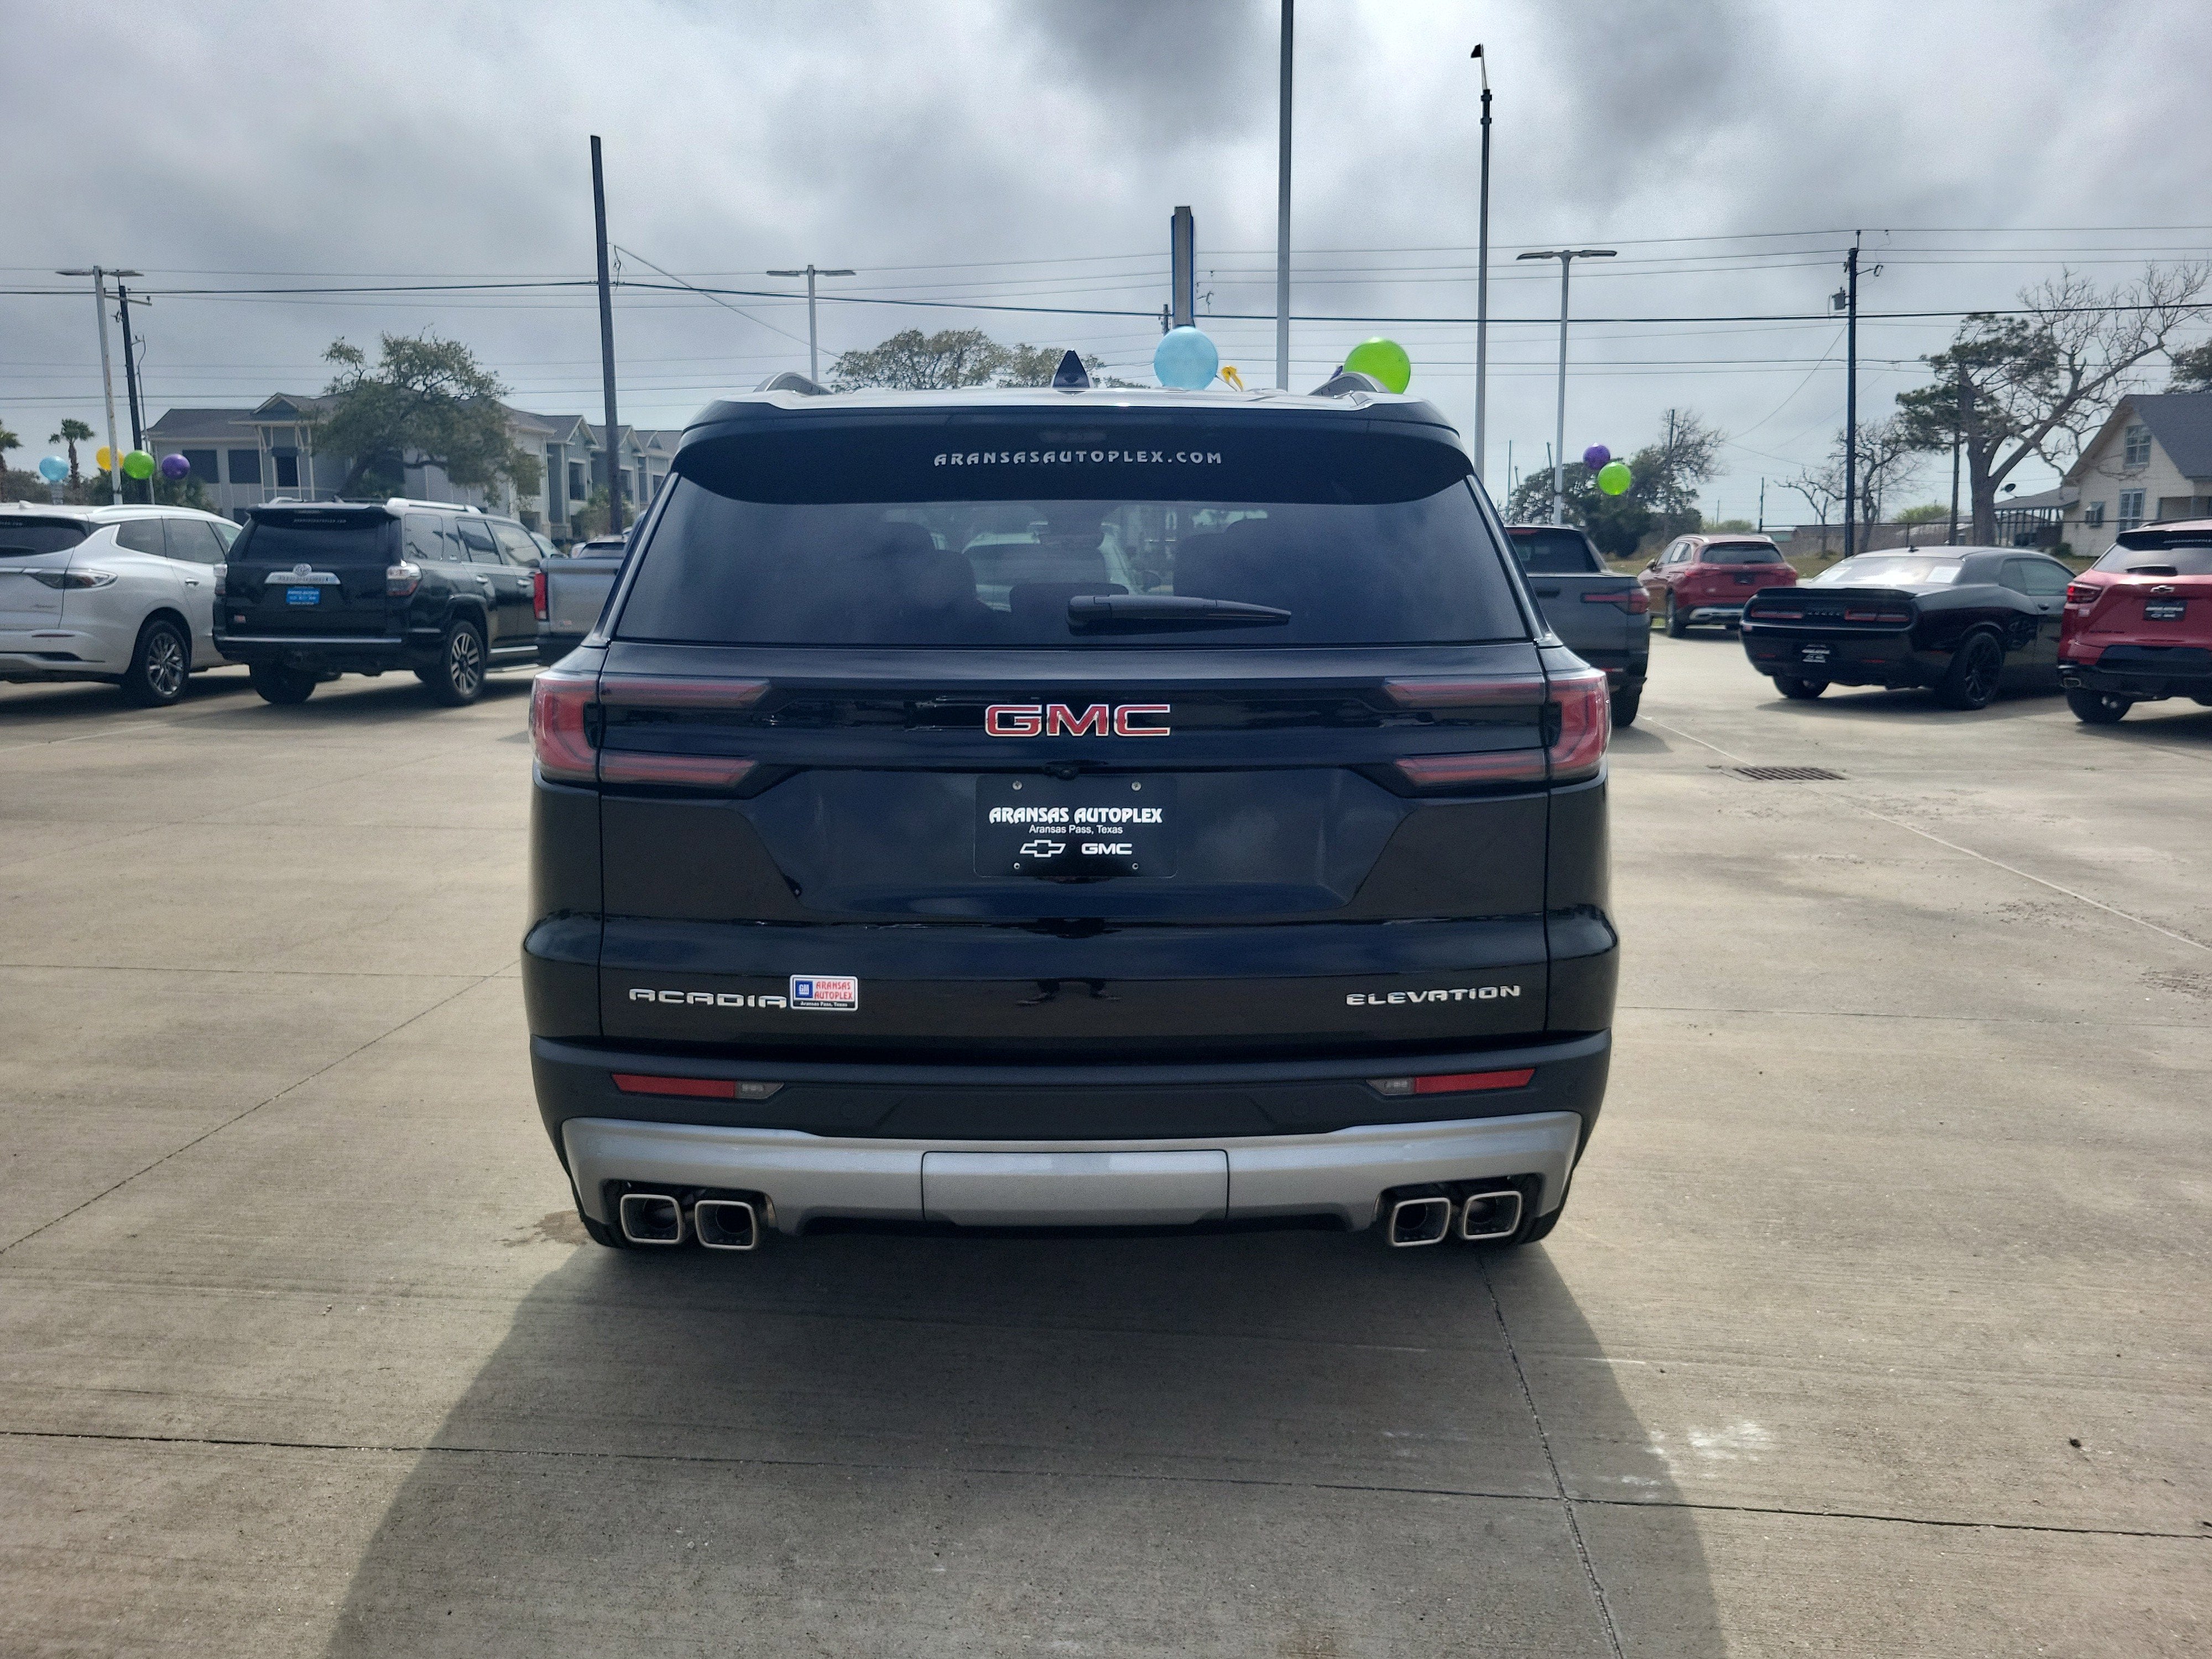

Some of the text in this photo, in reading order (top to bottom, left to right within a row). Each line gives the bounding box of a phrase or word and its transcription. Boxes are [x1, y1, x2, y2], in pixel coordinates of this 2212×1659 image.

[934, 451, 1222, 466] ARANSASAUTOPLEX.COM
[985, 704, 1170, 737] GMC
[989, 807, 1162, 824] ARANSAS AUTOPLEX
[1029, 825, 1123, 835] Aransas Pass, Texas
[1081, 843, 1133, 855] GMC
[629, 988, 787, 1008] ACADIA
[814, 991, 853, 1000] AUTOPLEX
[1346, 985, 1520, 1005] ELEVATION
